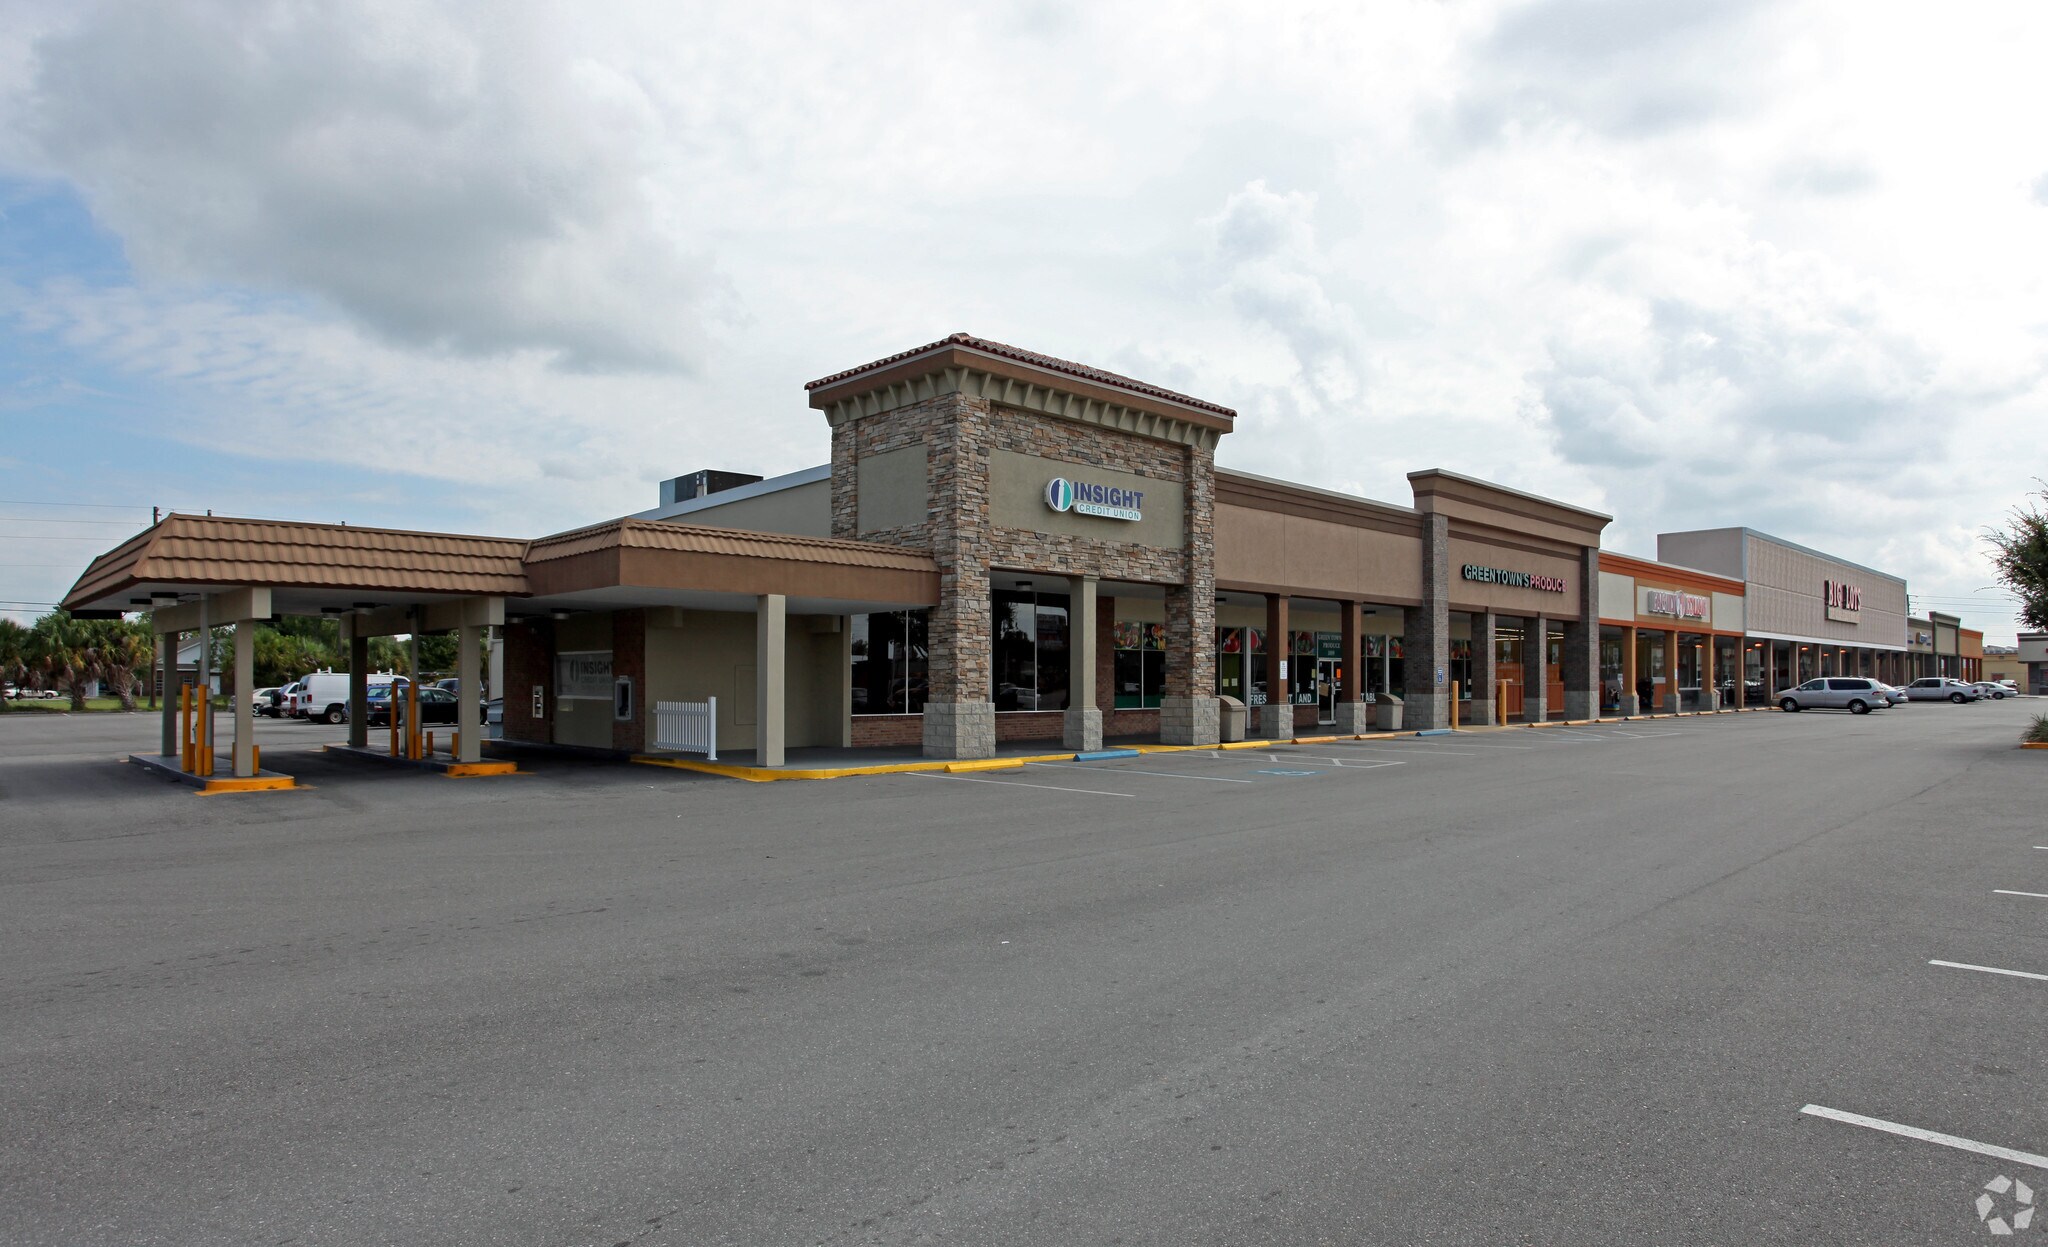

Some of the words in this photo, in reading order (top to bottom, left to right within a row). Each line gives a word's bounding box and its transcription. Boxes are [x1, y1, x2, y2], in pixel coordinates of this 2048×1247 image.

[1074, 482, 1143, 509] INSIGHT
[1079, 504, 1111, 516] CREDIT
[1113, 508, 1140, 520] UNION
[1463, 564, 1530, 588] GREENTOWN'S
[1529, 574, 1568, 593] PRODUCE
[1250, 694, 1267, 705] FRES
[1298, 693, 1312, 703] AND
